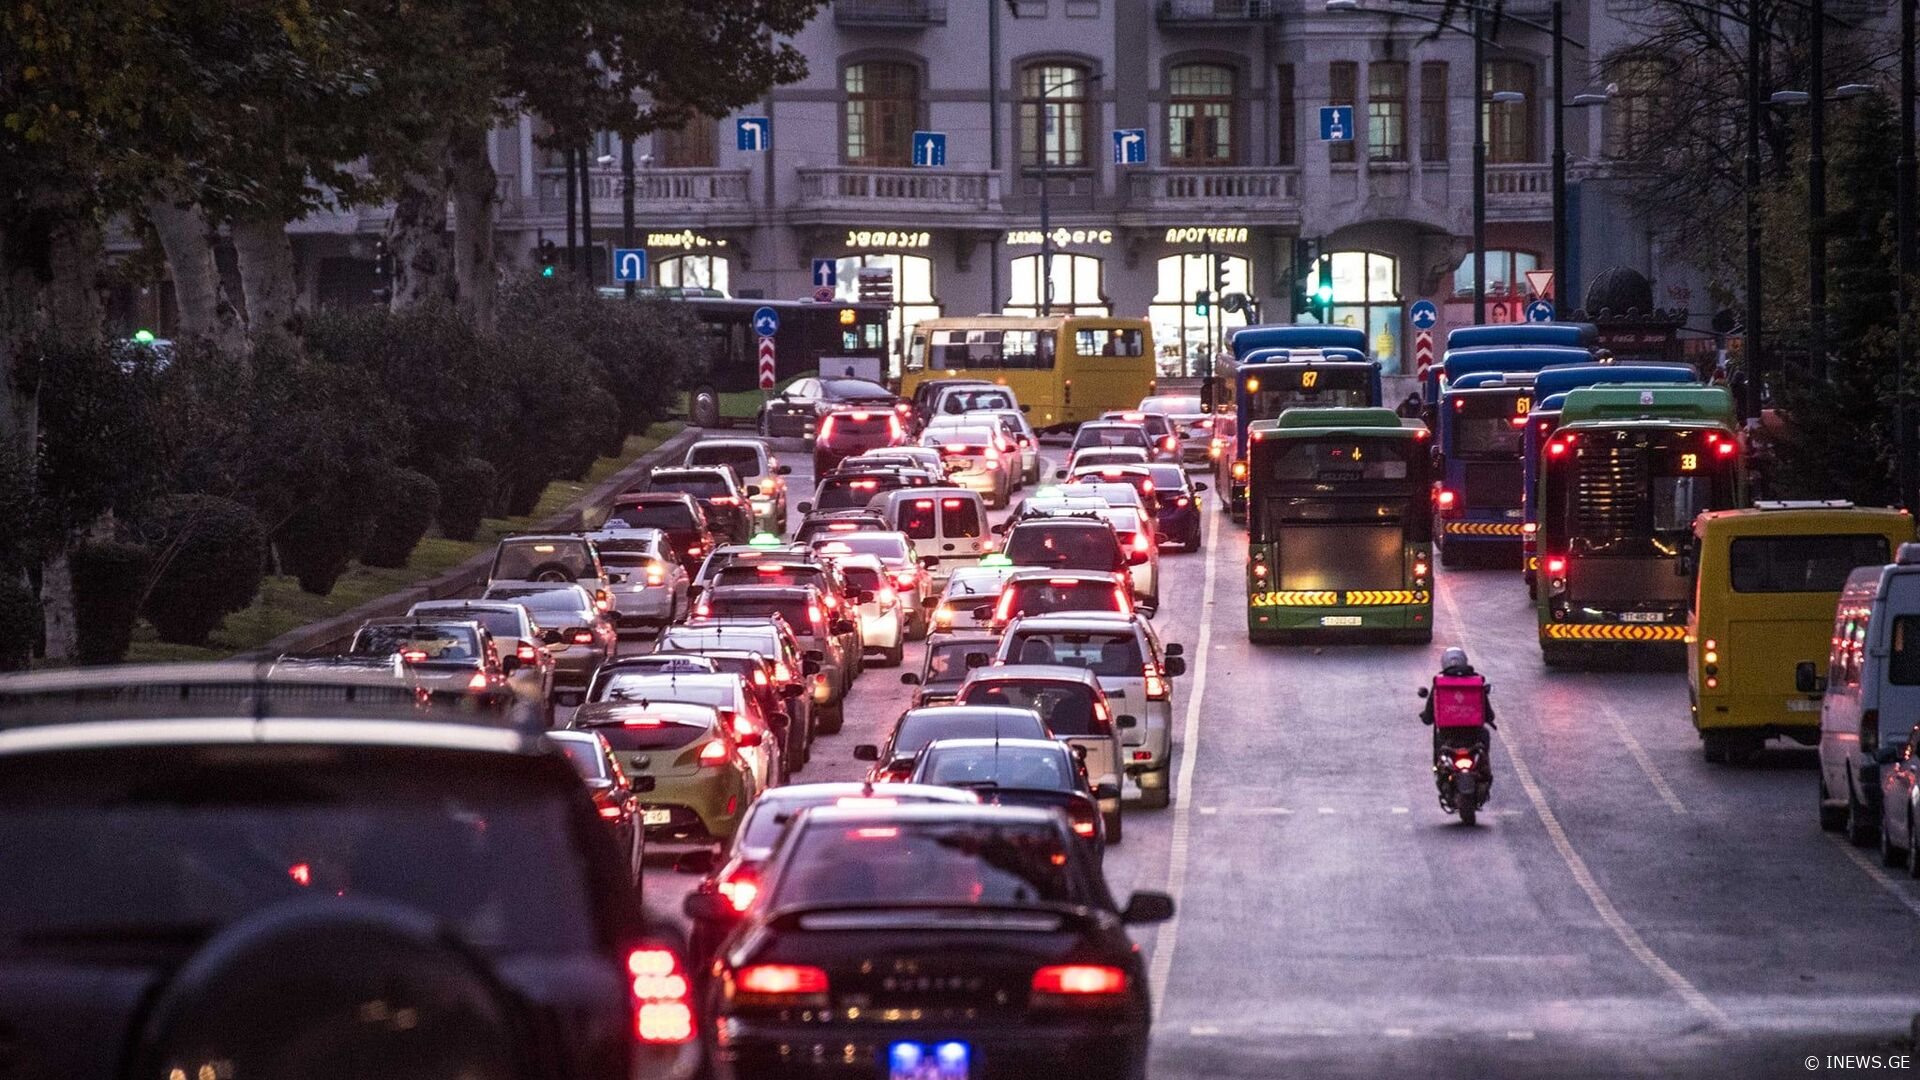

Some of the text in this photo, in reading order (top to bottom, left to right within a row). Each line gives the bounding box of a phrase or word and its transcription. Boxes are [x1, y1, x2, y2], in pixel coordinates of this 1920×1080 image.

[846, 231, 931, 247] აფთიაქი
[1072, 230, 1113, 244] GPC
[1302, 371, 1318, 387] 87
[1516, 397, 1530, 414] 61
